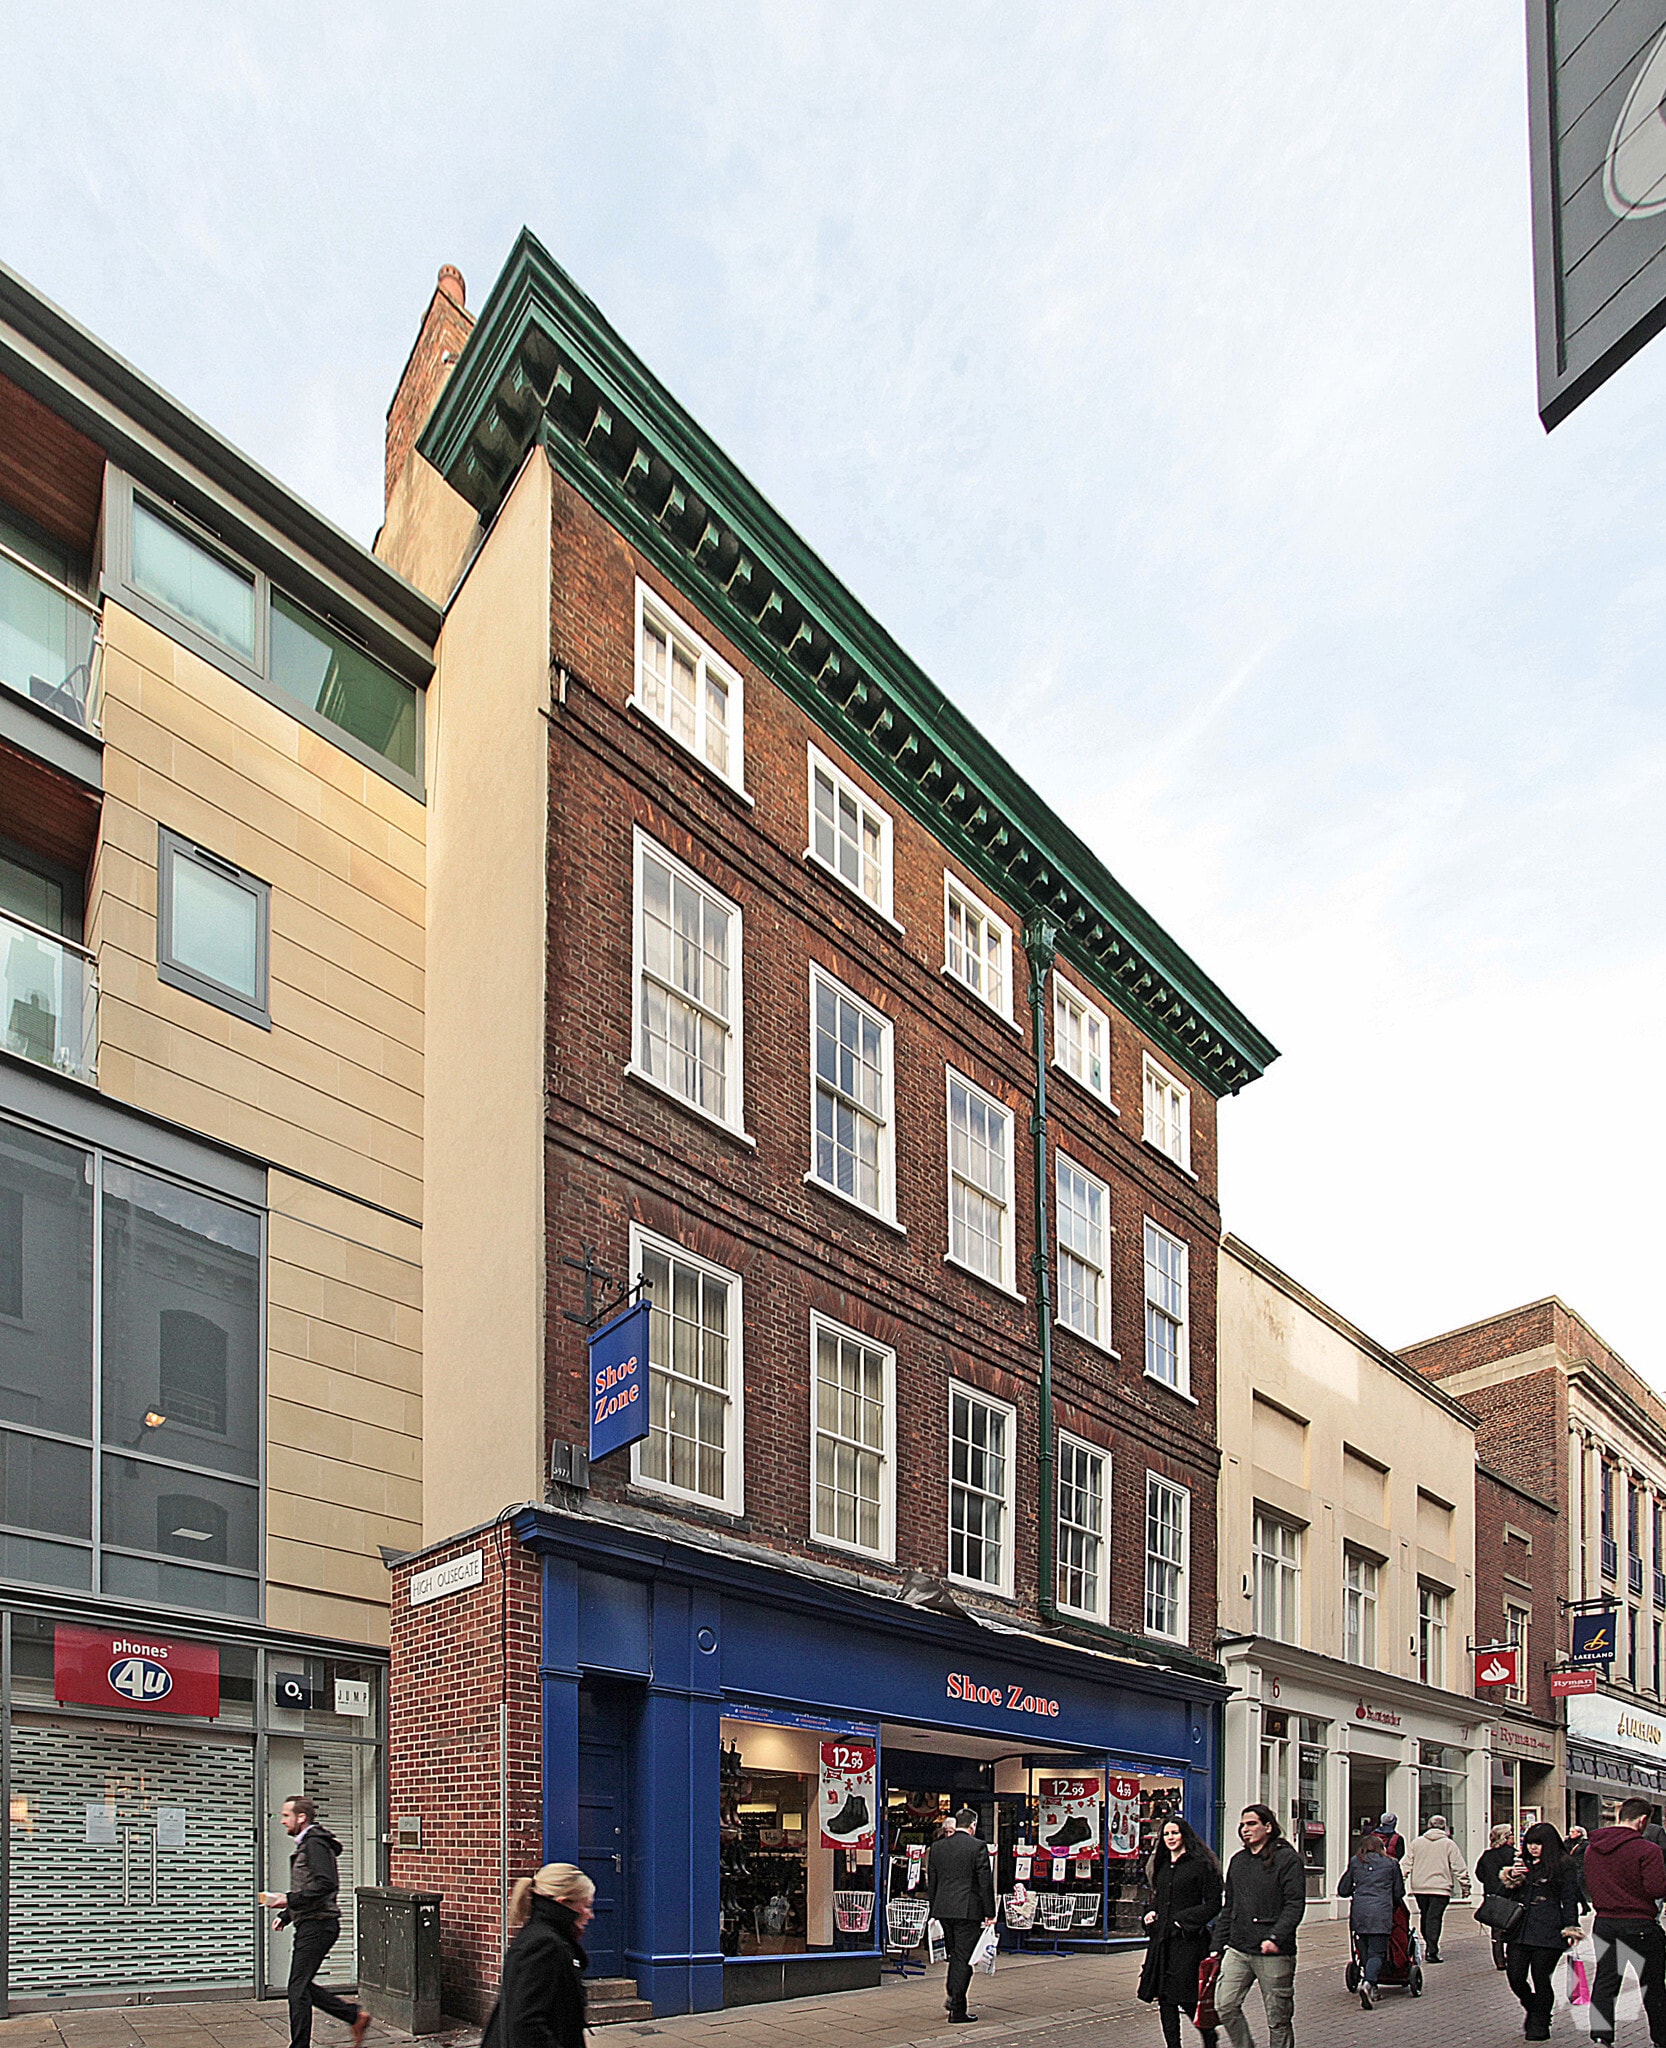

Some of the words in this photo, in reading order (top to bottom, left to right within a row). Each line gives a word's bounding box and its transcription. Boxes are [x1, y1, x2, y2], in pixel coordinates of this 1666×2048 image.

[595, 1356, 638, 1396] Shoe
[594, 1384, 639, 1424] Zone
[413, 1577, 433, 1598] HIGH
[437, 1560, 480, 1588] OUSEGATE
[112, 1638, 168, 1658] phones
[1573, 1651, 1614, 1661] LAKELAND
[1272, 1677, 1281, 1699] 6
[1553, 1679, 1593, 1688] Ryman
[338, 1689, 367, 1703] JUMP
[946, 1672, 1003, 1707] Shoe
[1006, 1684, 1060, 1718] Zone
[1500, 1727, 1538, 1749] Ryman
[1625, 1717, 1662, 1745] LAKELAND
